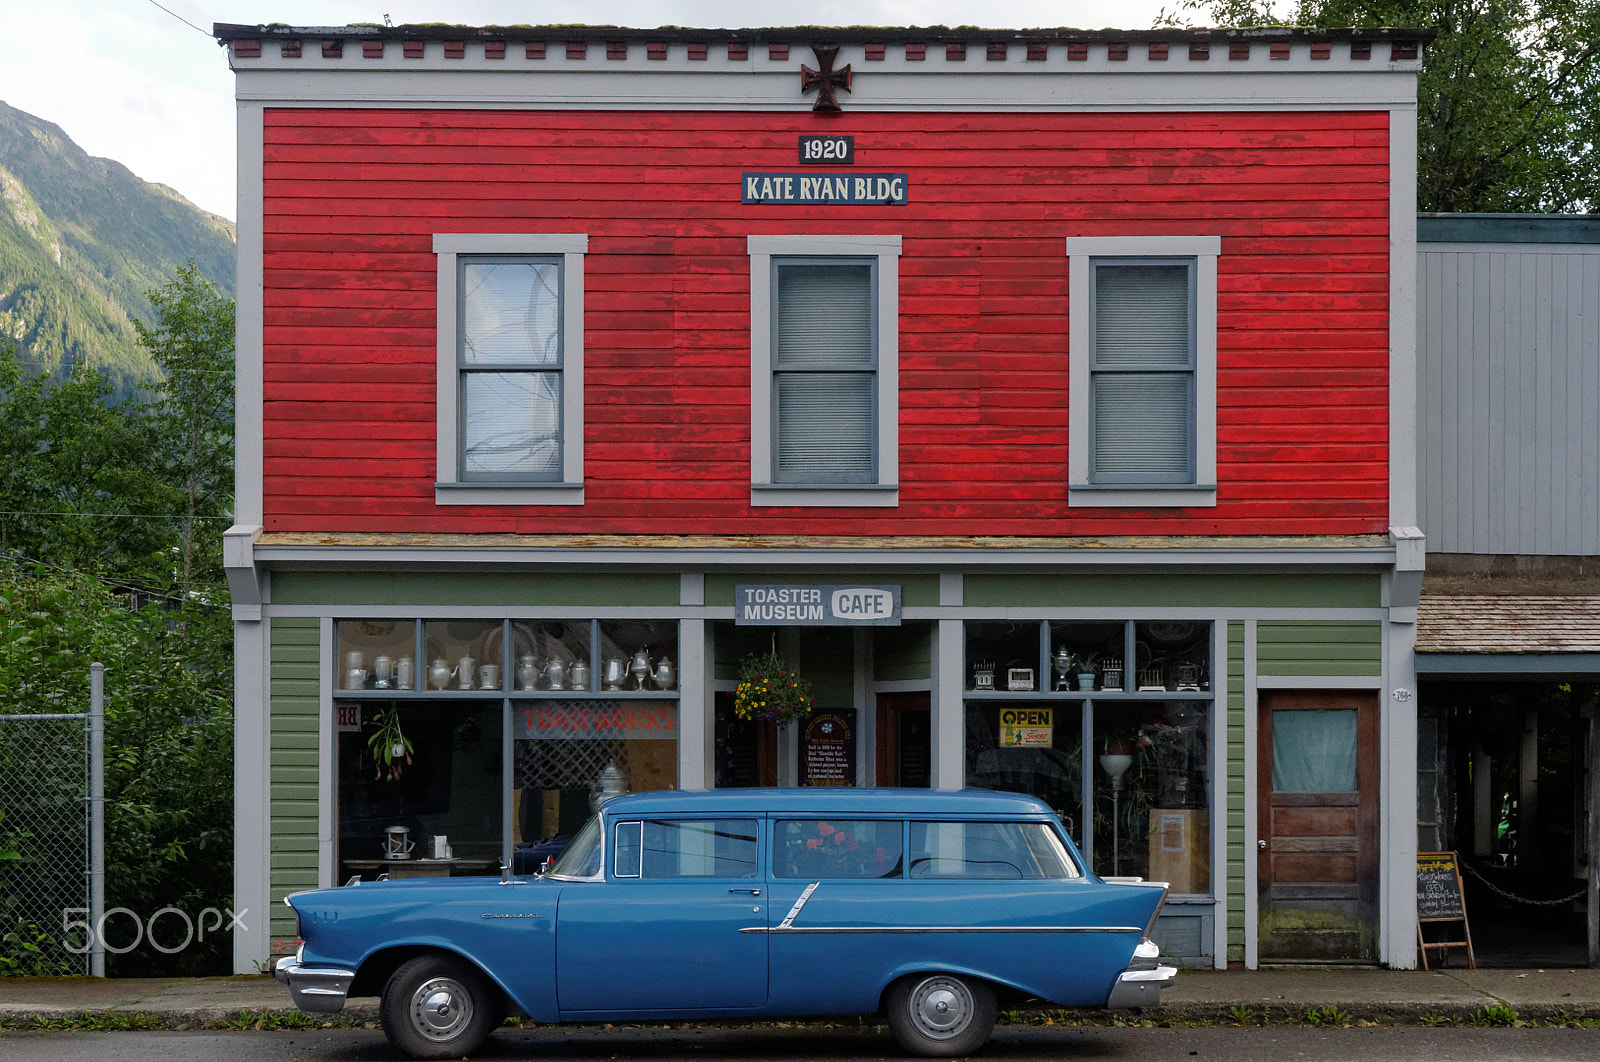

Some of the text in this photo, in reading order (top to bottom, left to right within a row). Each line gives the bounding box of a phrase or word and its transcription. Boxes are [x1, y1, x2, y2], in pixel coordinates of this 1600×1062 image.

[803, 139, 848, 159] 1920
[746, 177, 903, 201] KATE RYAN BLDG
[744, 589, 822, 603] TOASTER
[838, 594, 884, 614] CAFE
[744, 605, 824, 620] MUSEUM
[521, 707, 676, 732] TOASTWORKS
[1002, 710, 1050, 725] OPEN
